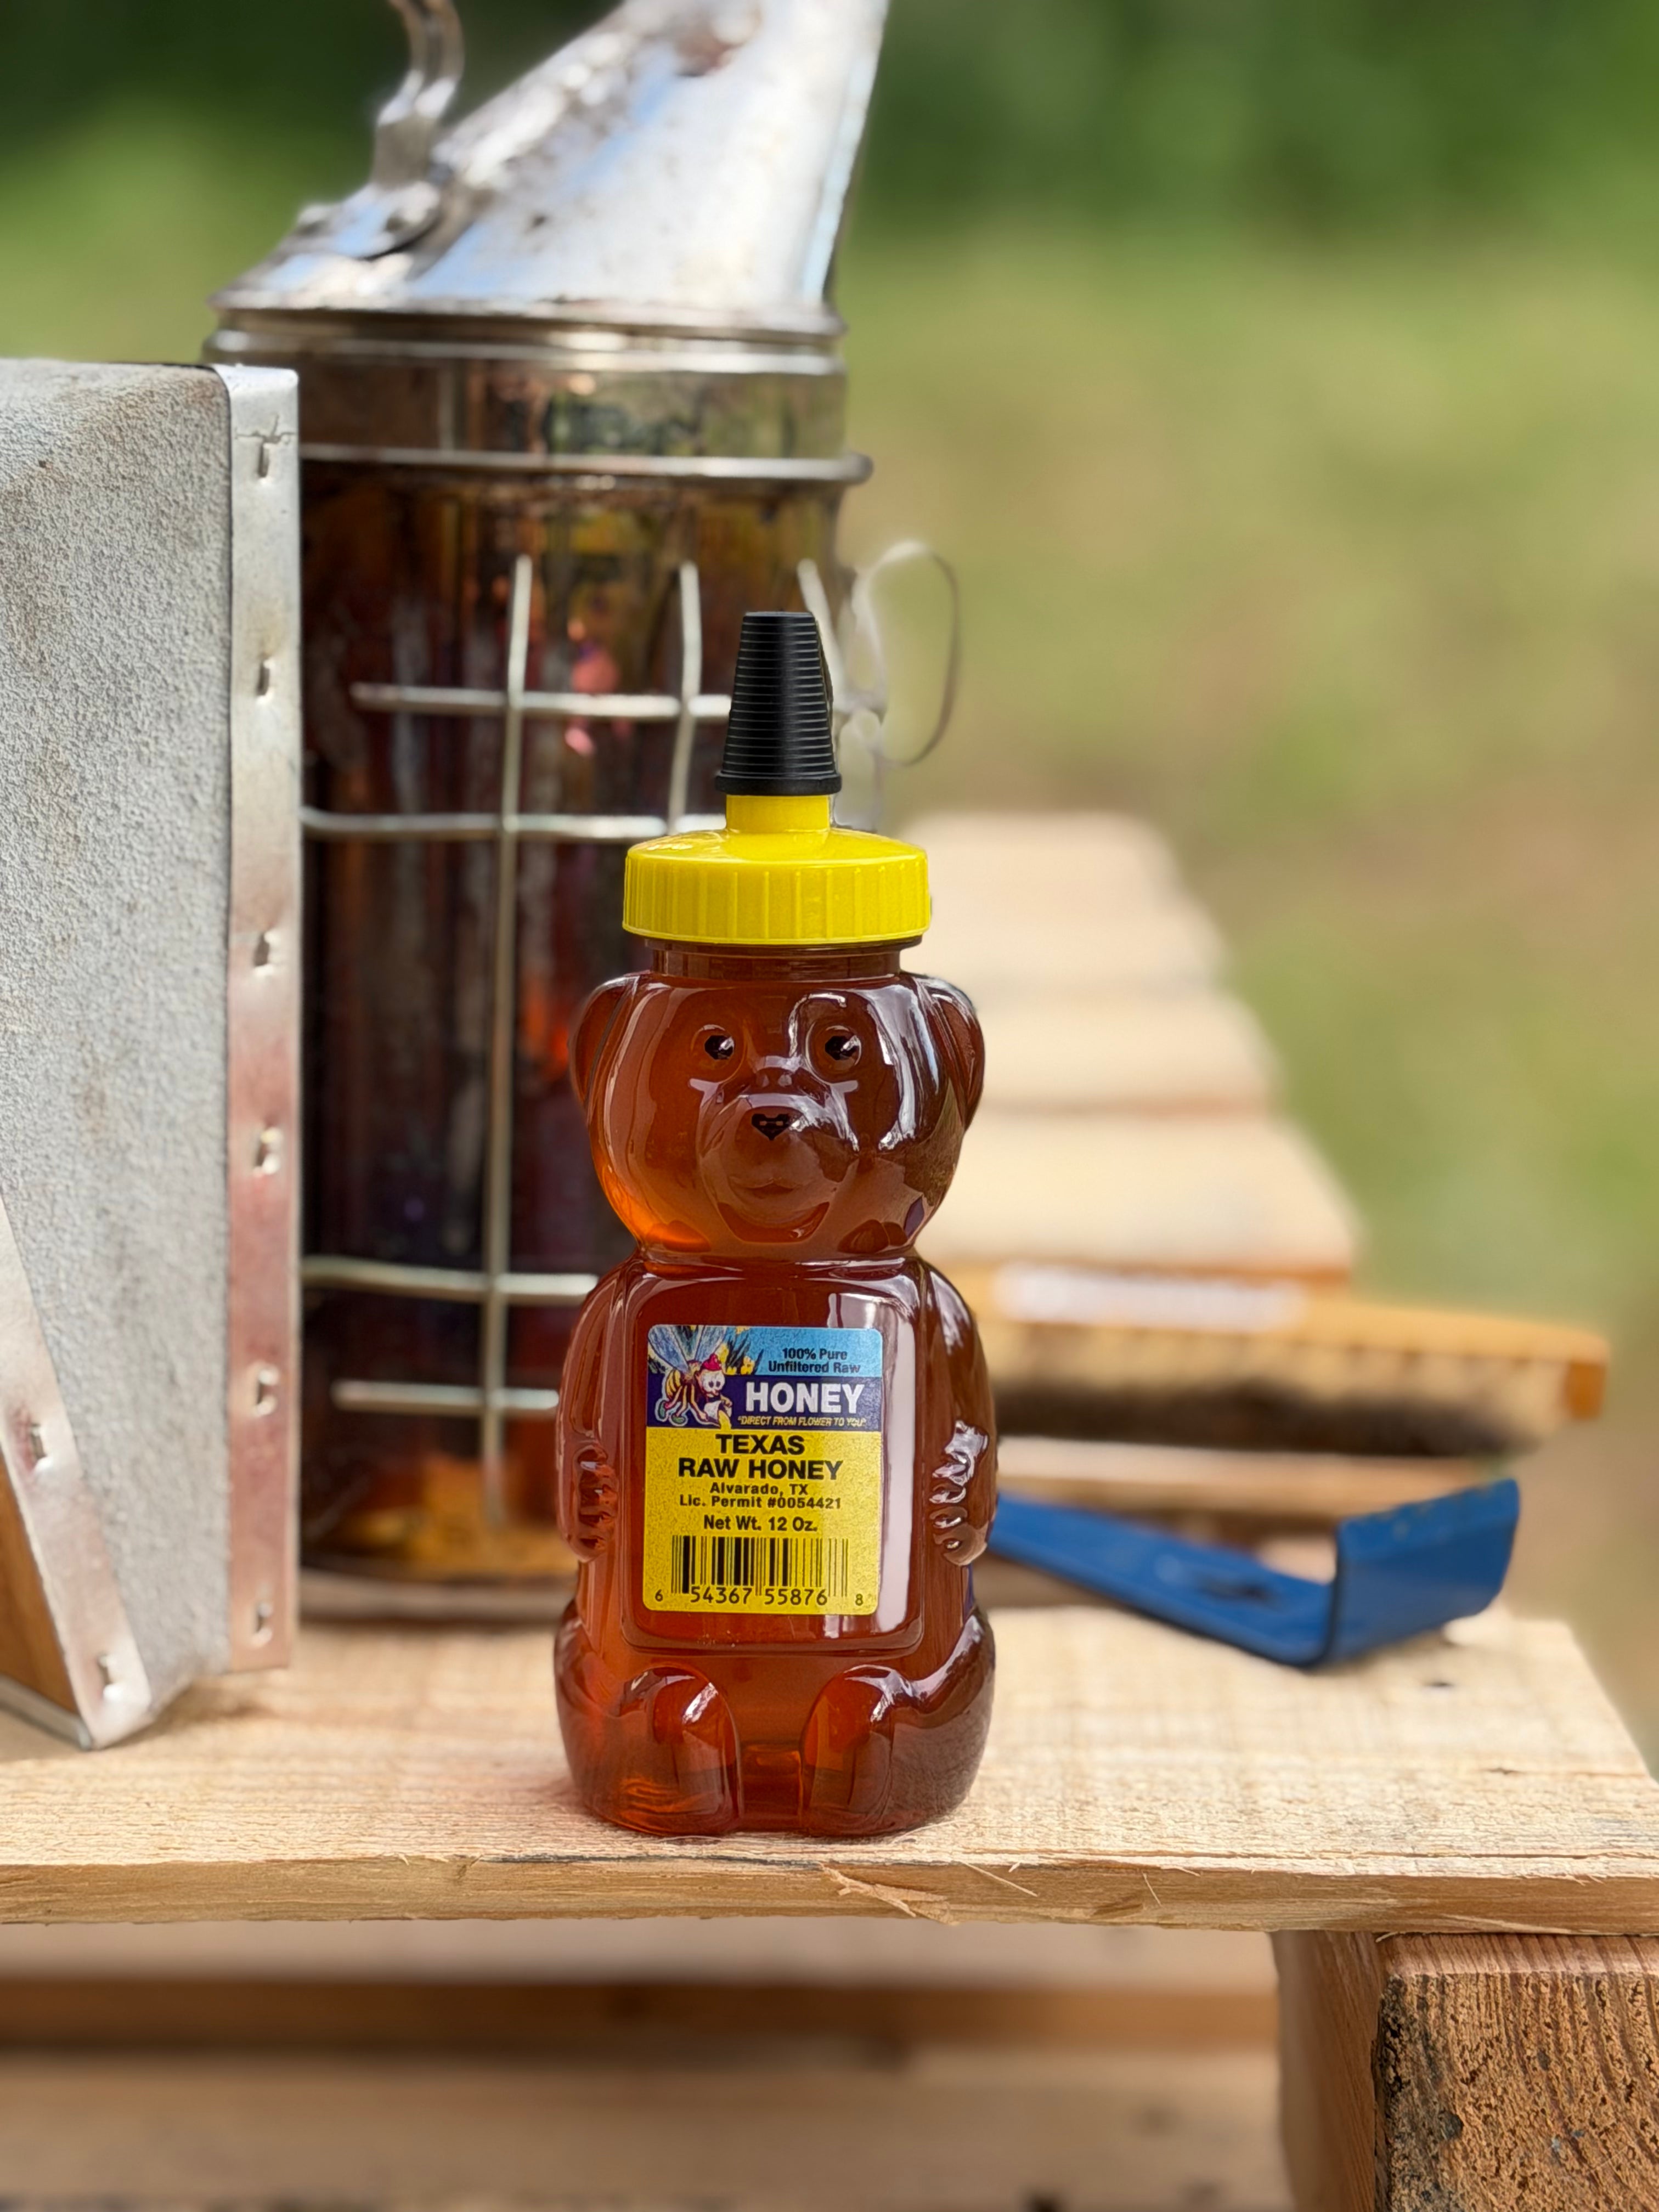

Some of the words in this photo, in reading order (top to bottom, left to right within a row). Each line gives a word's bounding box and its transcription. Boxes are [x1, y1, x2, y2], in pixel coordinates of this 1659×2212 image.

[782, 1348, 816, 1360] 100%
[819, 1348, 848, 1360] Pure
[769, 1361, 829, 1373] Unfiltered
[833, 1362, 861, 1373] Raw
[746, 1382, 865, 1414] HONEY
[772, 1416, 797, 1426] FROM
[798, 1417, 832, 1426] FLOWER
[833, 1417, 845, 1426] TO
[715, 1434, 805, 1455] TEXAS
[678, 1458, 739, 1479] RAW
[748, 1459, 843, 1481] HONEY
[709, 1482, 784, 1497] Alvarado,
[789, 1484, 809, 1496] TX
[680, 1495, 706, 1507] Lic.
[712, 1496, 762, 1509] Permit
[768, 1497, 841, 1510] #0054421
[704, 1515, 730, 1531] Net
[736, 1516, 761, 1531] Wt.
[769, 1517, 787, 1532] 12
[792, 1518, 818, 1532] Oz.
[654, 1590, 664, 1602] 6
[690, 1586, 752, 1604] 54367
[764, 1588, 828, 1606] 55876
[855, 1594, 864, 1606] 8
